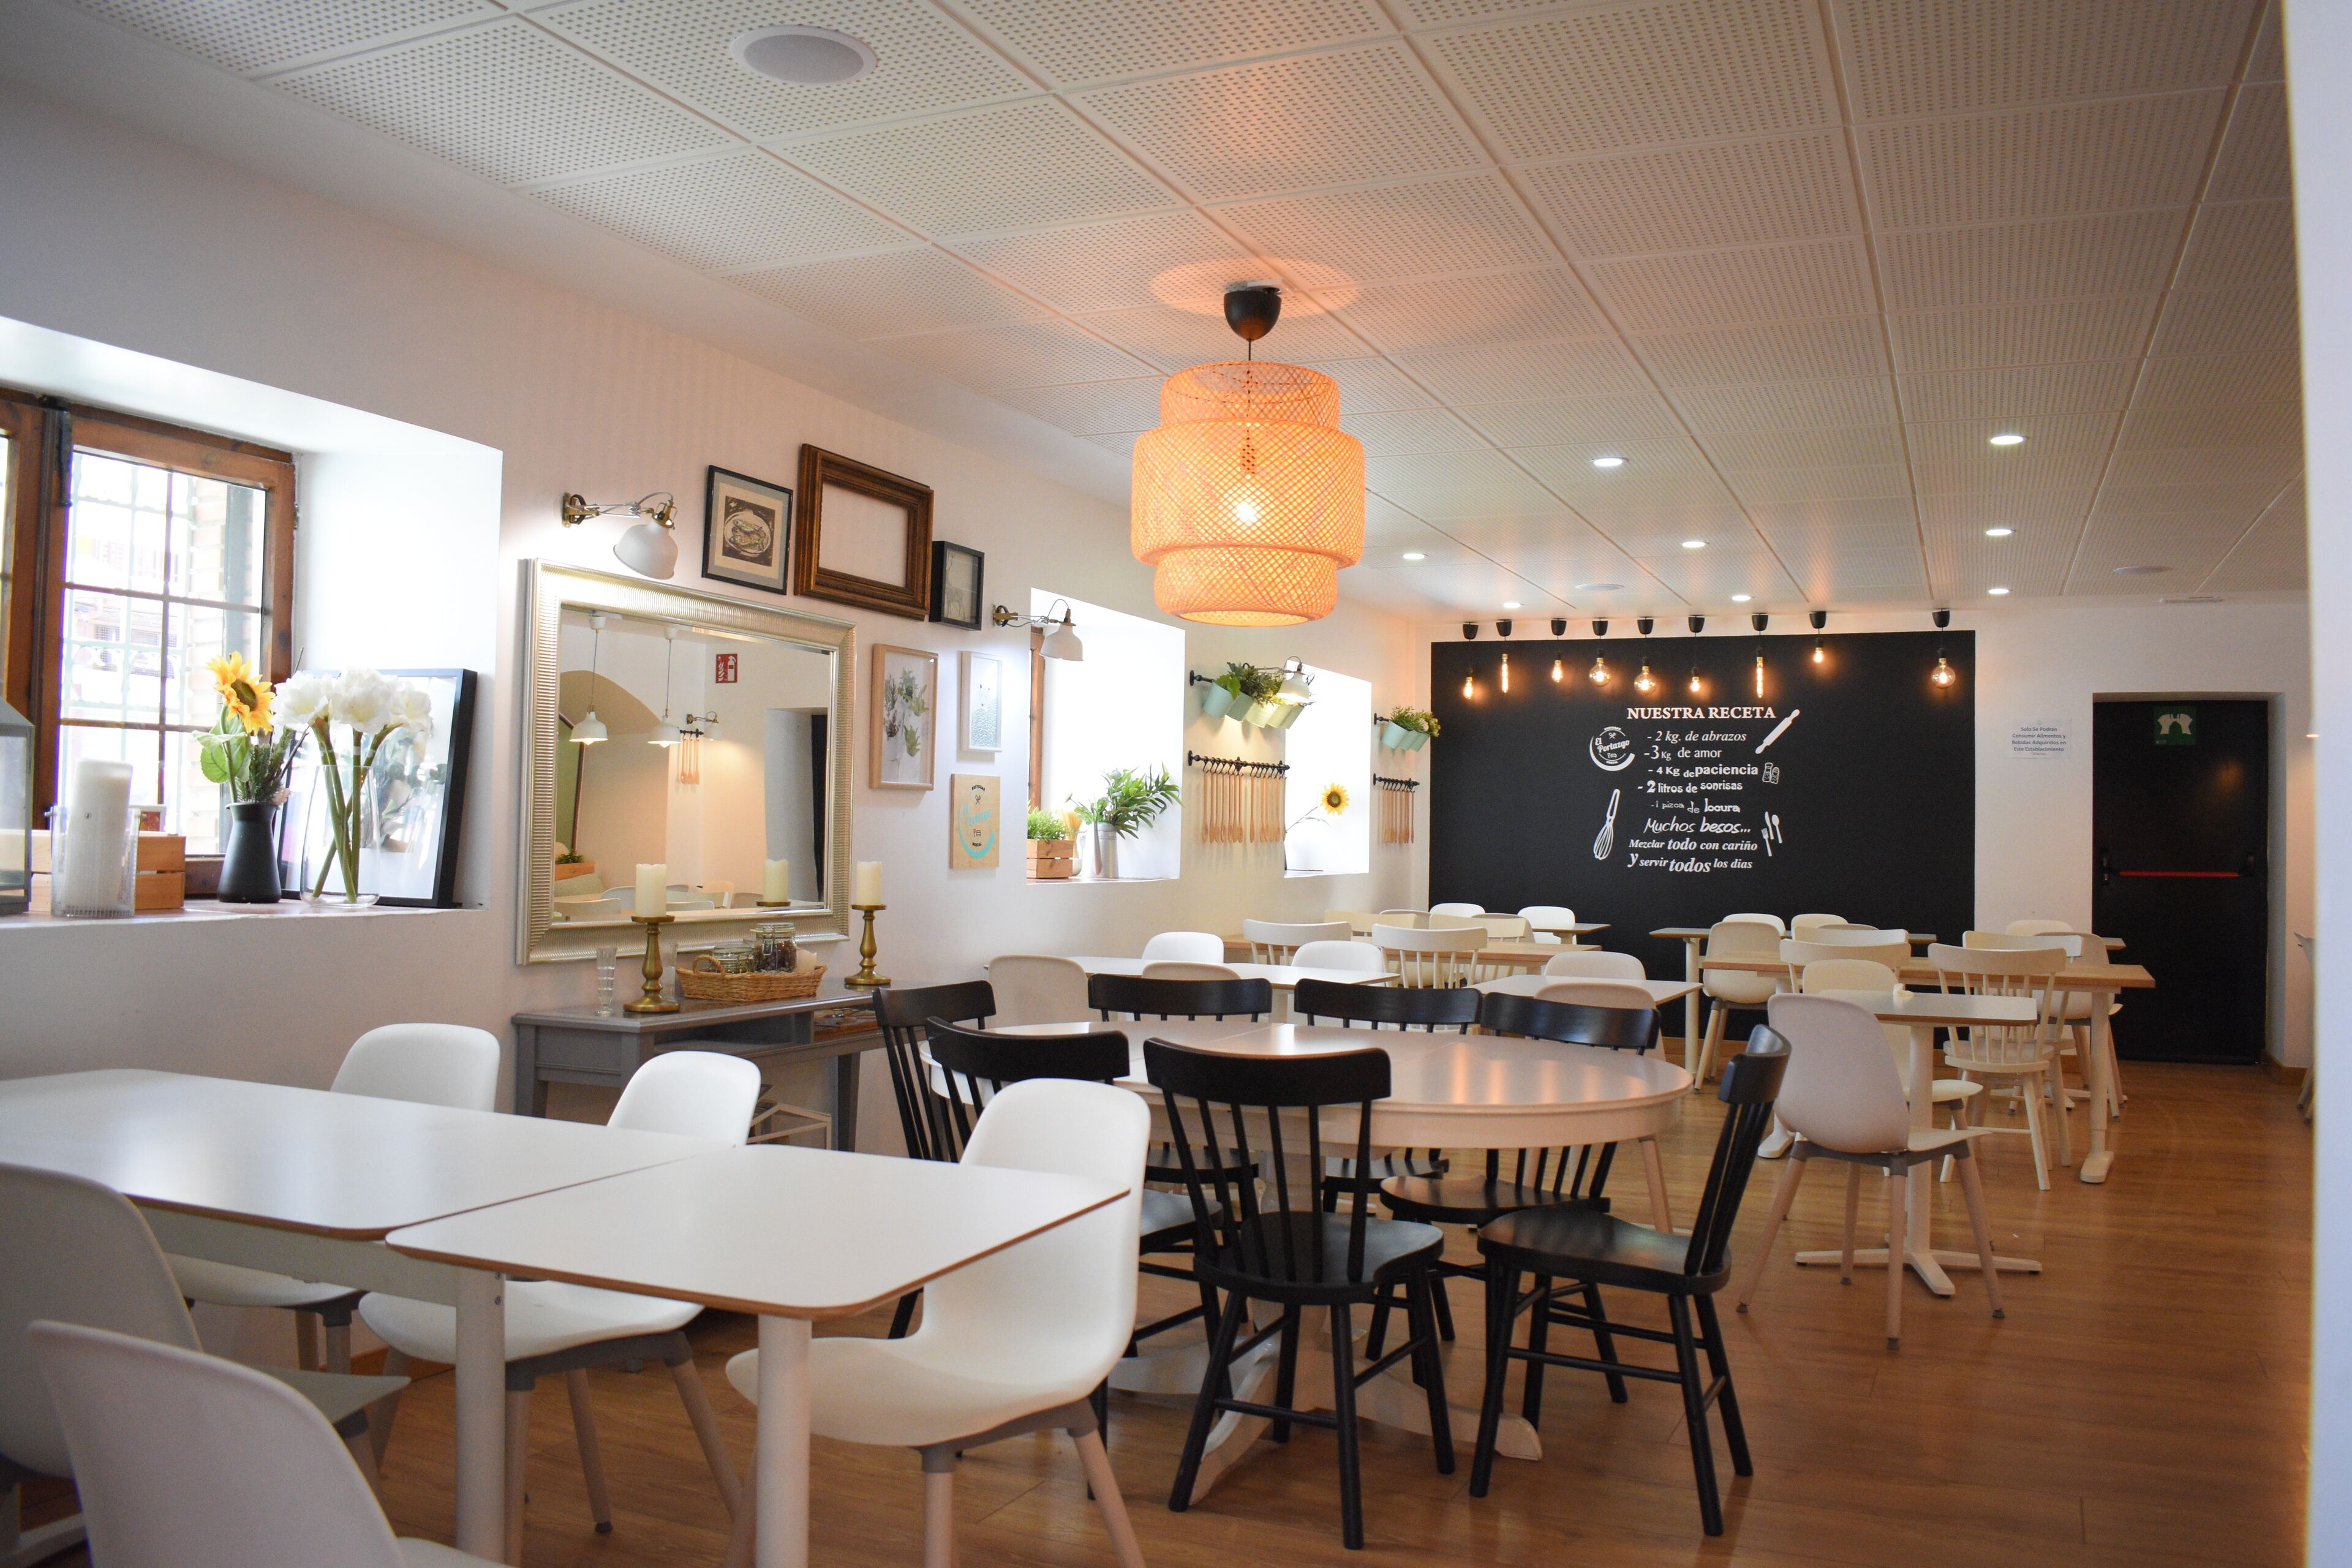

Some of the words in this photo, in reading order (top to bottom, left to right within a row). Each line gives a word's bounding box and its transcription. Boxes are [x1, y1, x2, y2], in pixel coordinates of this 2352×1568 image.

[1626, 707, 1706, 720] NUESTRA
[1708, 706, 1776, 719] RECETA
[1595, 737, 1602, 746] El
[1654, 730, 1663, 741] 2
[1665, 730, 1681, 744] kg.
[1684, 730, 1699, 741] de
[1701, 730, 1747, 741] abrazos
[1597, 740, 1630, 753] Portazgo
[1661, 751, 1672, 761] Kg
[1677, 747, 1691, 758] de
[1694, 750, 1722, 758] amor
[1656, 766, 1664, 775] 4
[1665, 766, 1681, 777] Kg
[1683, 769, 1695, 778] de
[1695, 763, 1758, 777] paciencia
[1646, 780, 1656, 793] 2
[1657, 782, 1684, 793] litros
[1685, 782, 1698, 793] de
[1700, 780, 1743, 791] sonrisas
[1662, 801, 1685, 810] pizca
[1686, 801, 1700, 813] de
[1704, 797, 1741, 813] locura
[1643, 815, 1696, 834] Muchos
[1628, 839, 1665, 849] Mezclar
[1667, 837, 1697, 851] todo
[1722, 840, 1758, 851] cariño
[1627, 853, 1639, 868] y
[1638, 857, 1669, 867] servir
[1668, 857, 1712, 873] todos
[1713, 858, 1728, 869] los
